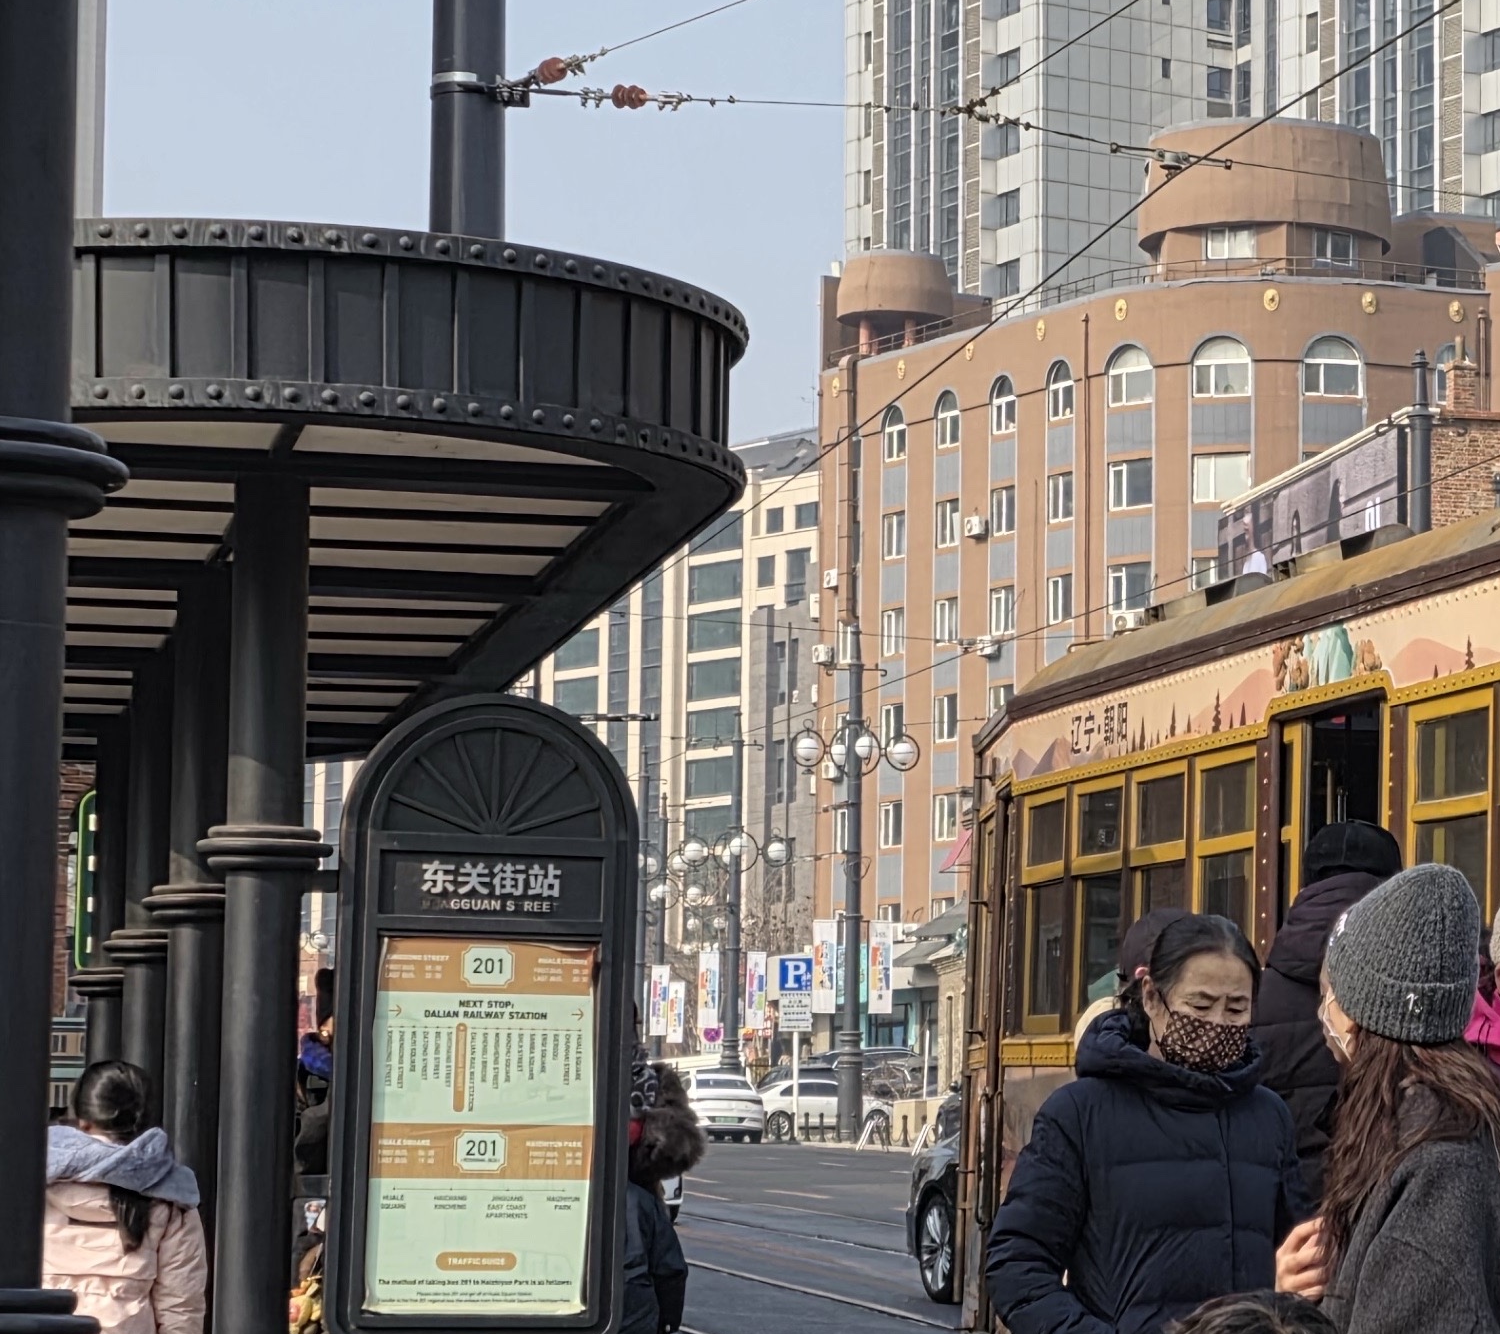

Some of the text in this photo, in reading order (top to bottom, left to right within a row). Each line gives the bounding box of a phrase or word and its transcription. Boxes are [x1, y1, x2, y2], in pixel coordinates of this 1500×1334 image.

[421, 860, 562, 897] 东关街站
[473, 958, 504, 974] 201
[785, 961, 806, 988] P
[459, 1000, 484, 1008] NEXT
[424, 1009, 548, 1020] DALIAN RAILWAY STATION
[466, 1140, 496, 1156] 201
